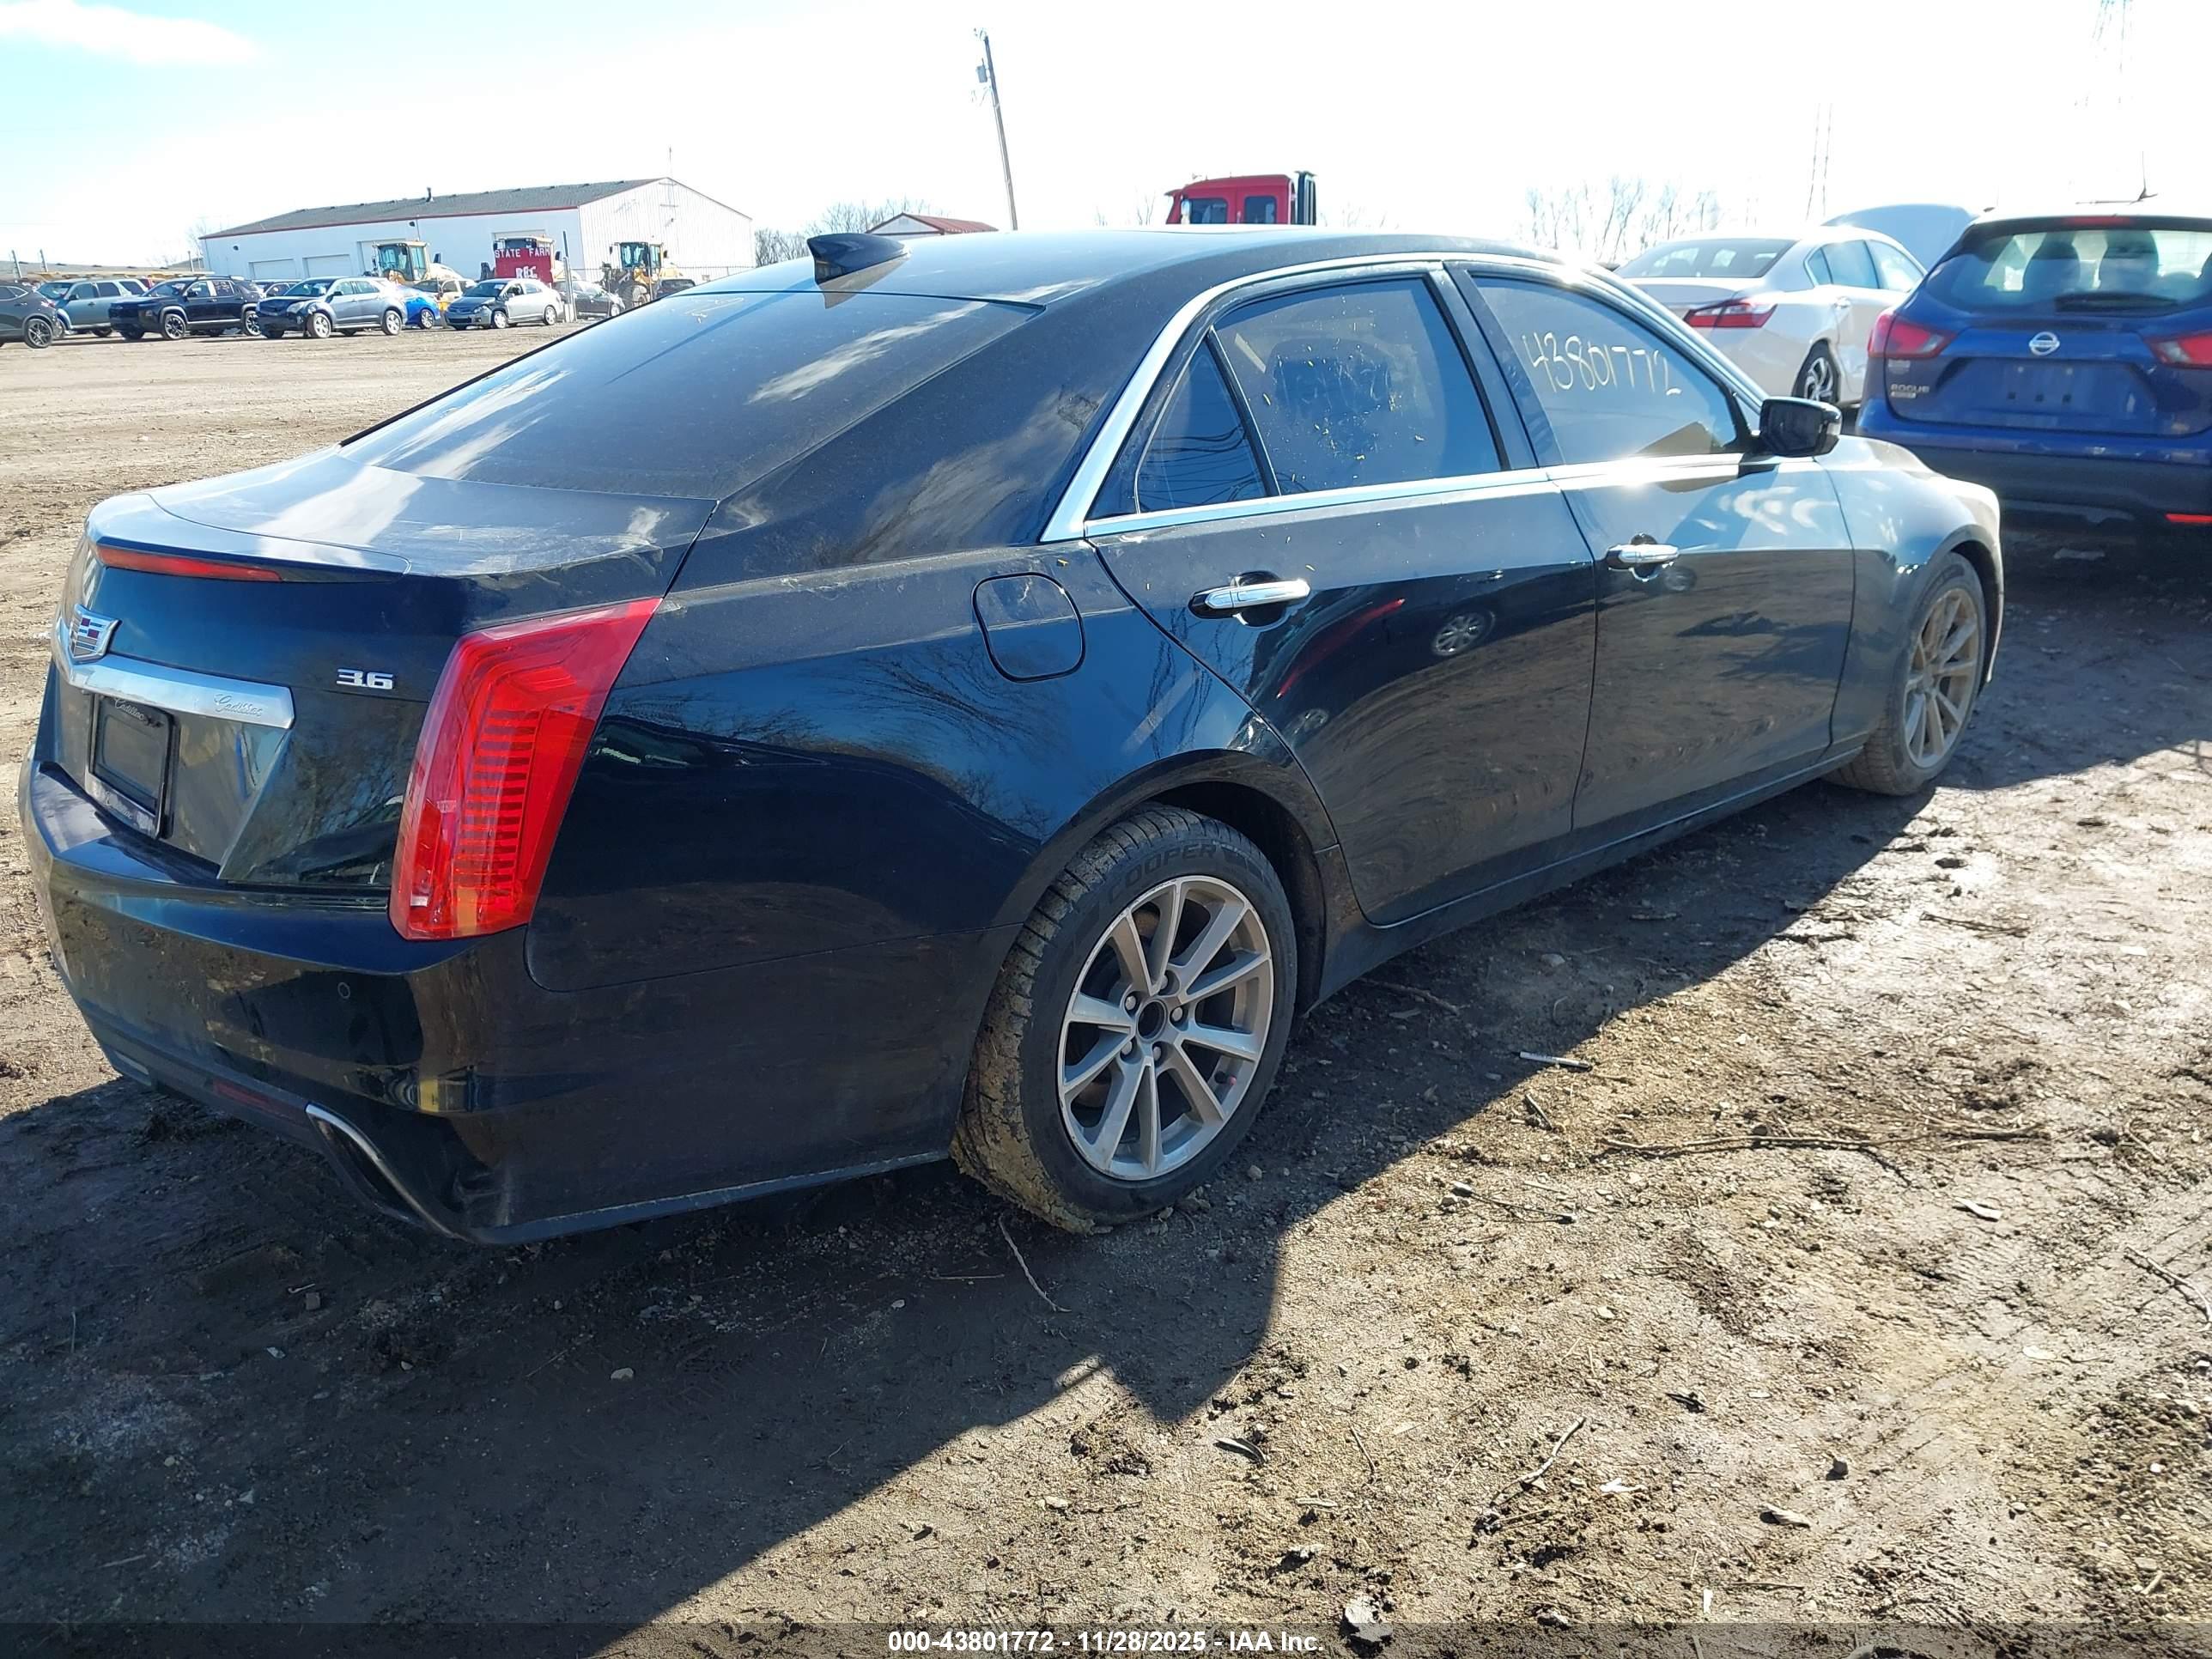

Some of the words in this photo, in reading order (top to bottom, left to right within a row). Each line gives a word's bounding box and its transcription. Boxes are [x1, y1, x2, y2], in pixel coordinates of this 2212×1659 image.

[495, 248, 521, 258] STATE
[528, 246, 550, 258] FARM
[1522, 331, 1682, 396] 43801772
[114, 696, 145, 721] Cadillac
[214, 693, 263, 719] Cadillac
